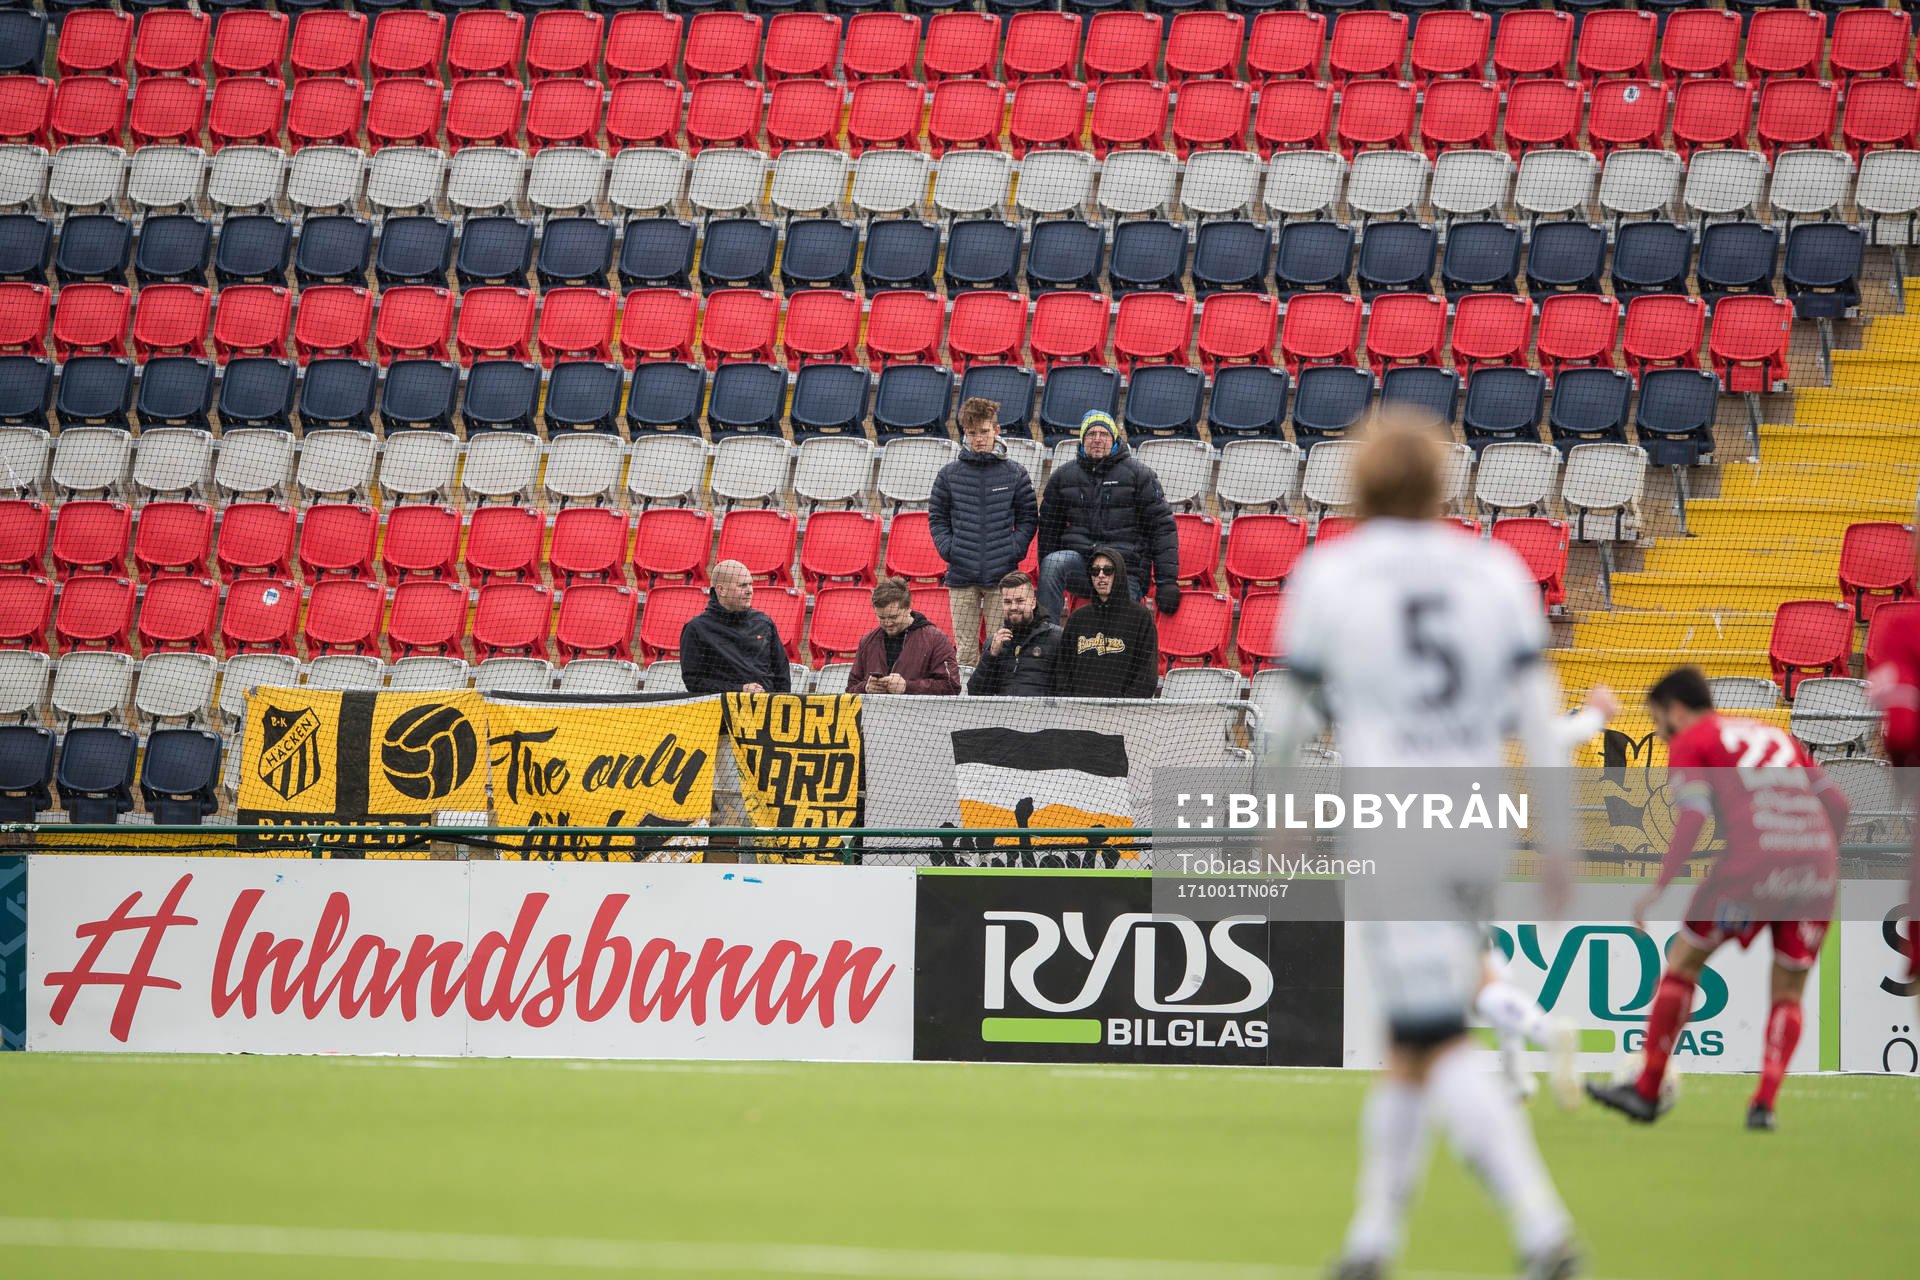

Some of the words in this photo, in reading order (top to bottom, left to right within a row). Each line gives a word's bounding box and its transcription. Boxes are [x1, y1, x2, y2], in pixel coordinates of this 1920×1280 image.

[1403, 593, 1463, 711] 5
[726, 691, 863, 750] WORK
[582, 733, 707, 805] only
[746, 749, 855, 806] ARD
[983, 911, 1274, 1013] RYDS
[1107, 1018, 1269, 1048] BILGLAS
[1623, 1029, 1725, 1056] GAS
